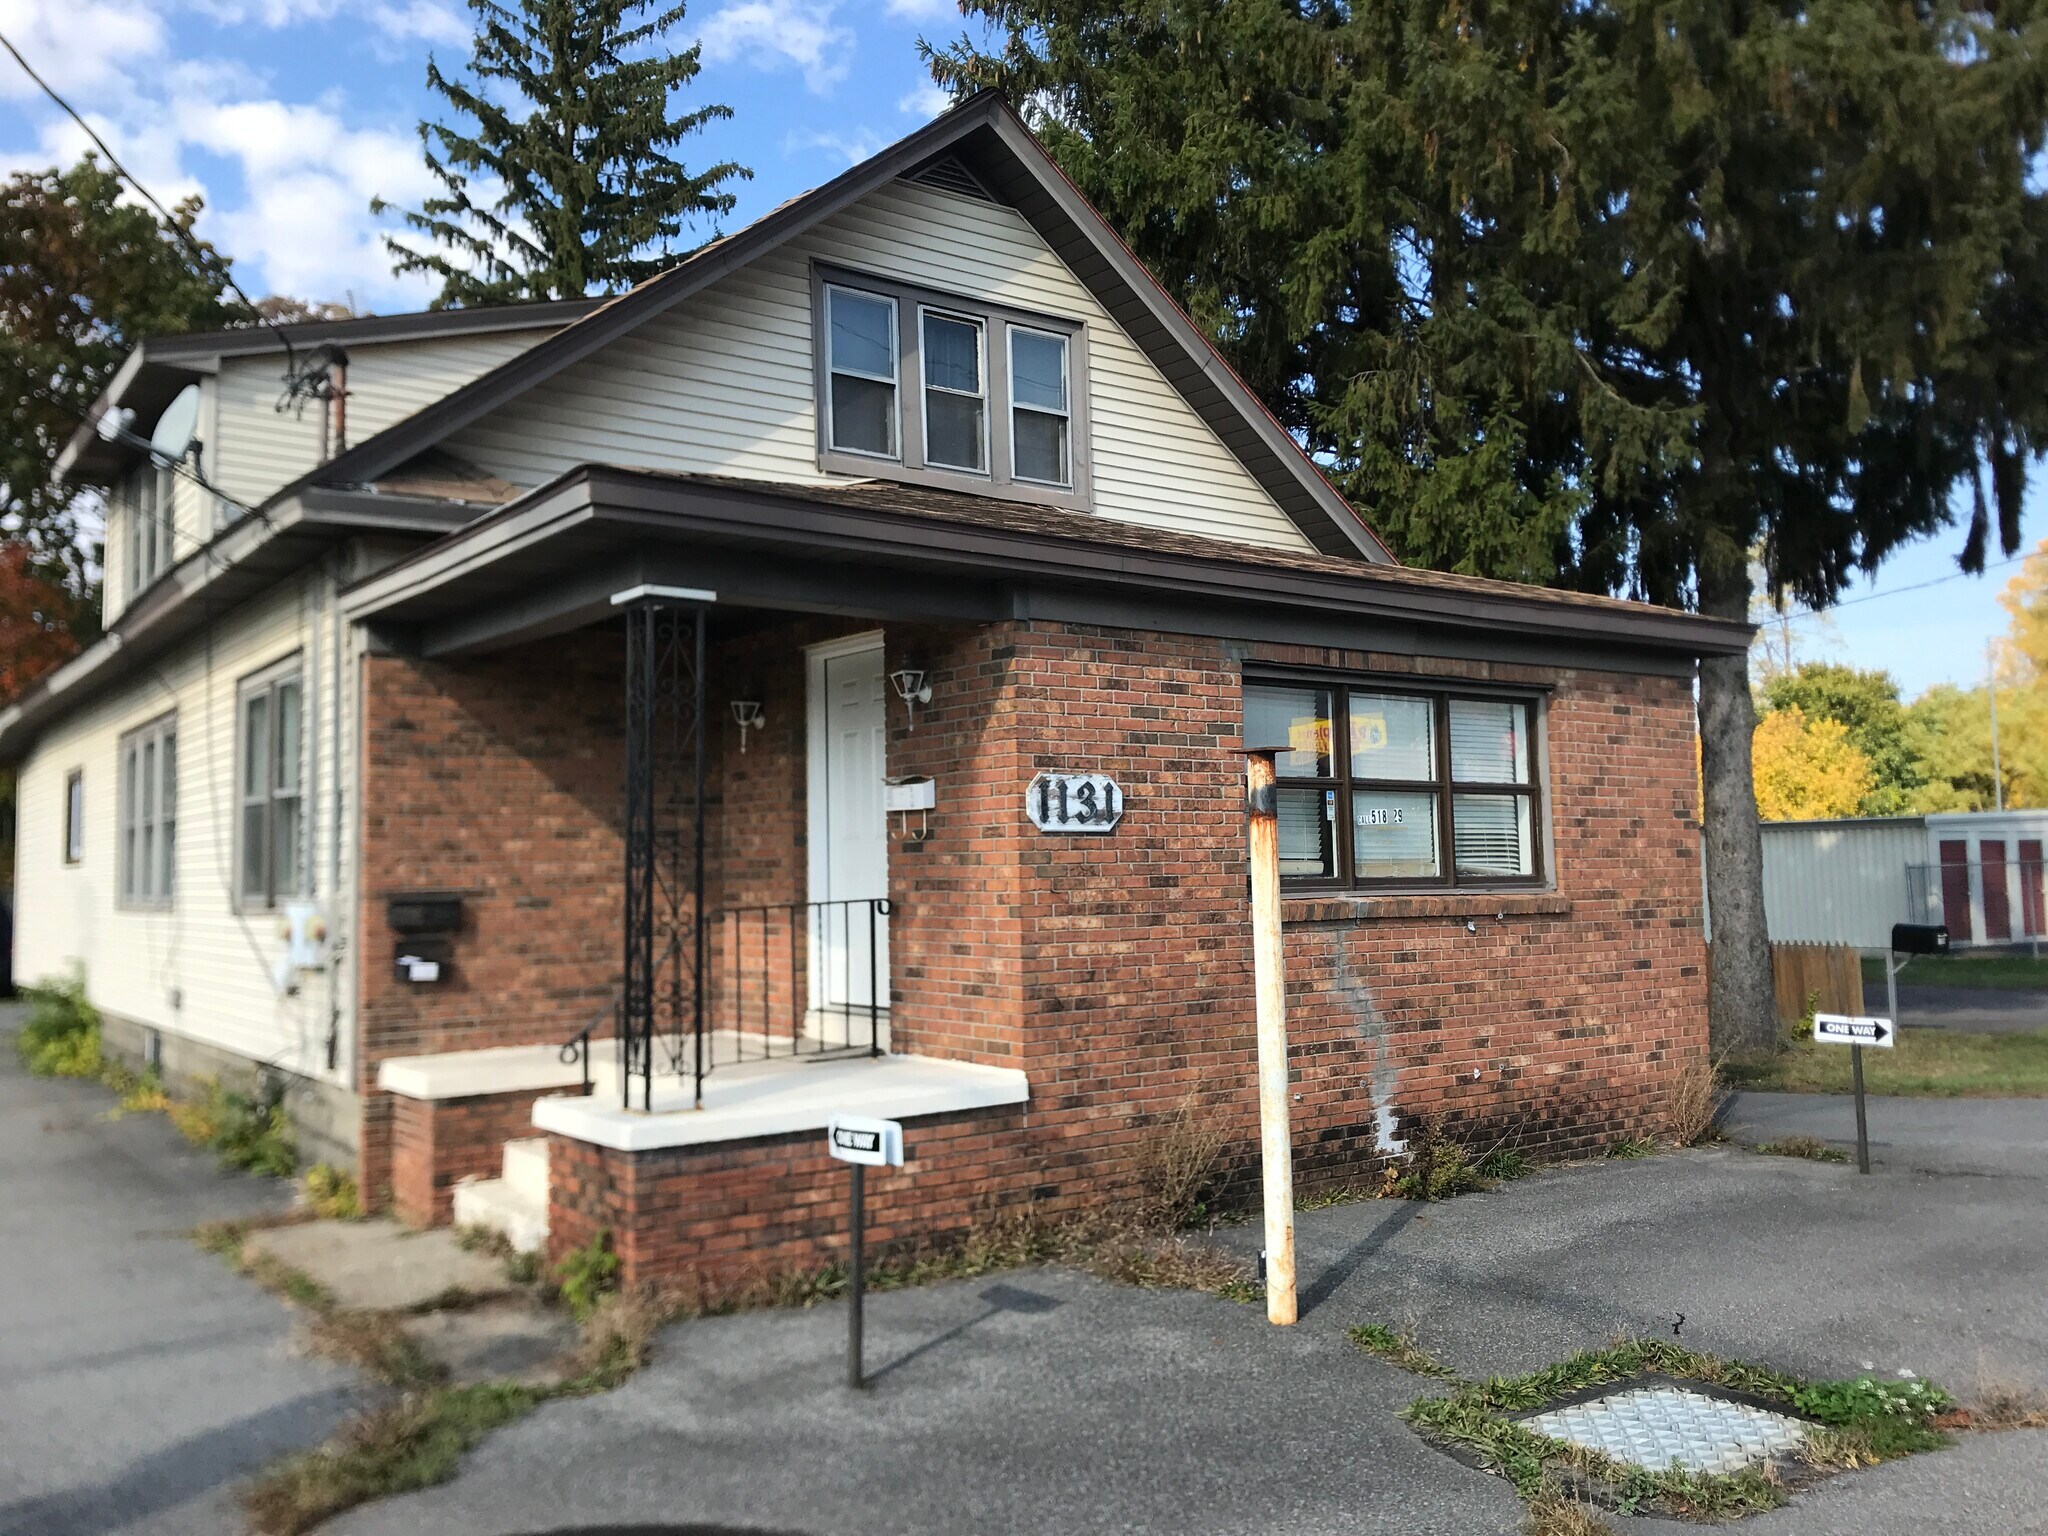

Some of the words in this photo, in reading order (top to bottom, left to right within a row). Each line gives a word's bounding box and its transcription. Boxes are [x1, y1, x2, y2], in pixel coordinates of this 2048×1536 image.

[1039, 779, 1114, 824] 1131
[1371, 810, 1387, 824] 518
[1826, 1023, 1849, 1034] ONE
[1851, 1025, 1876, 1036] WAY
